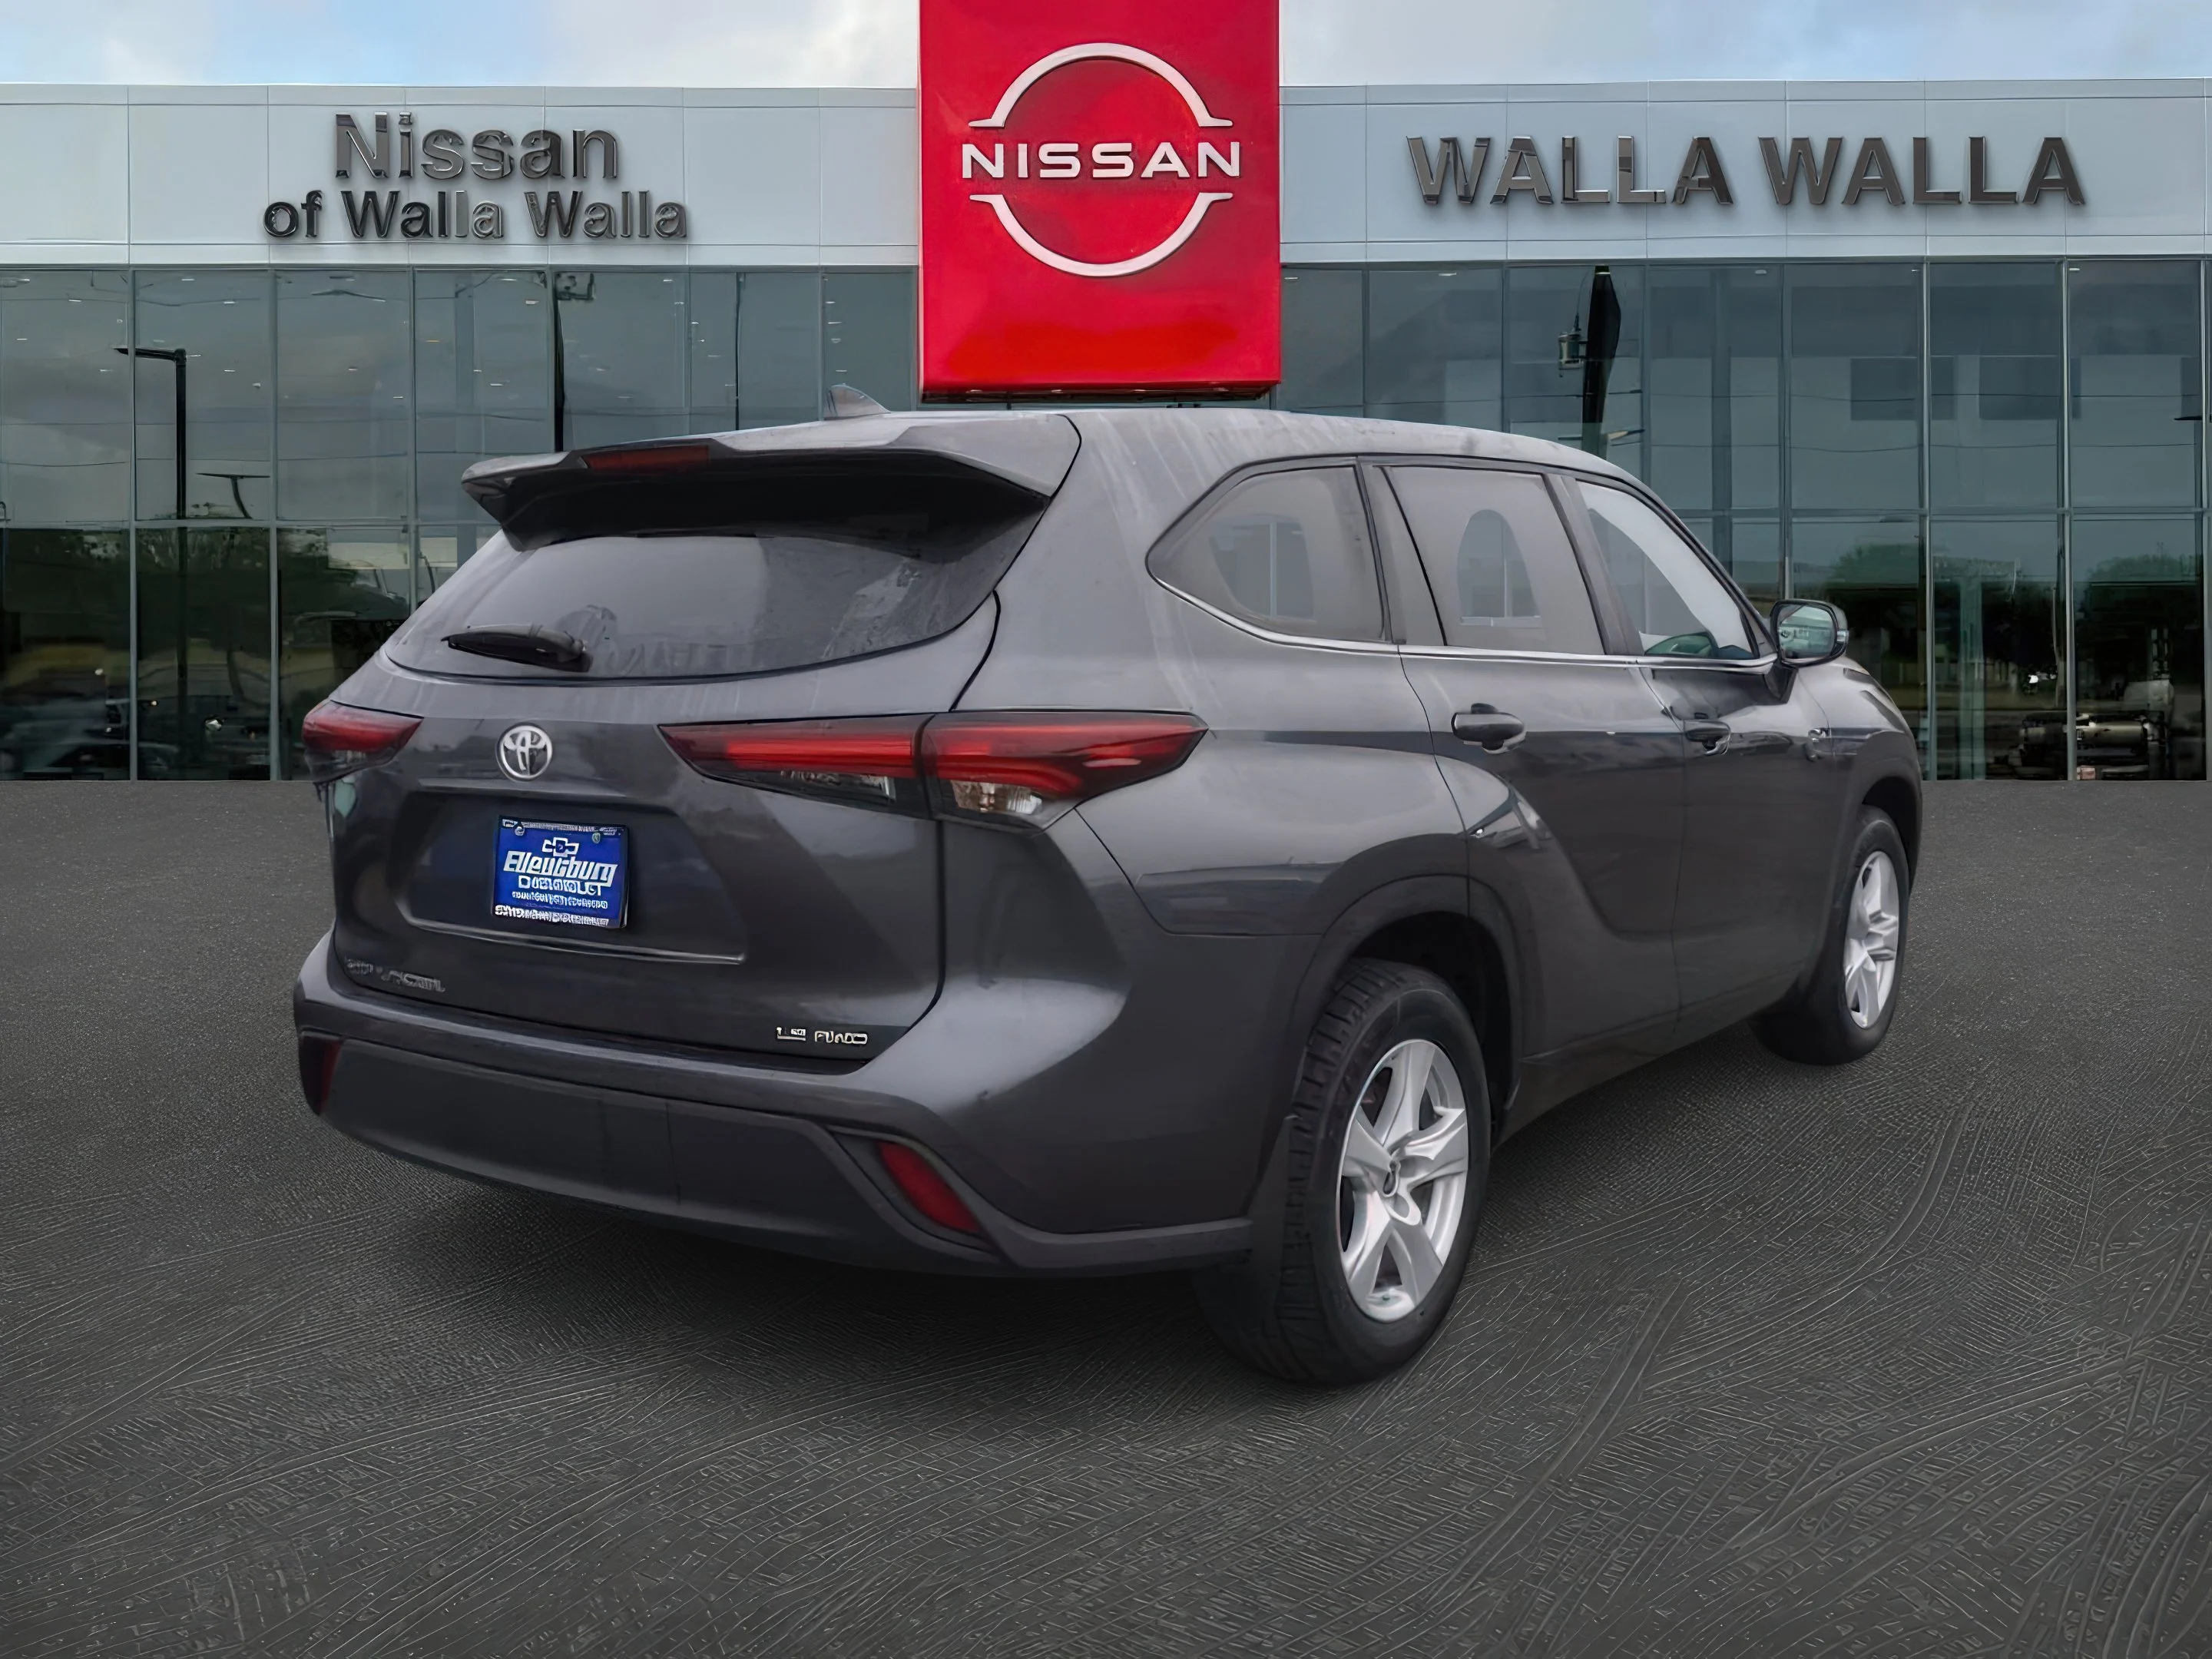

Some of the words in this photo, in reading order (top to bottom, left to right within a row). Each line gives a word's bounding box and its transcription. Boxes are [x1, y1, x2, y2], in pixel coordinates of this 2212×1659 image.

[335, 111, 618, 180] Nissan
[962, 141, 1240, 179] NISSAN
[1406, 135, 1734, 205] WALLA
[1757, 137, 2086, 206] WALLA
[263, 189, 323, 238] of
[340, 190, 505, 238] Walla
[524, 190, 688, 239] Walla
